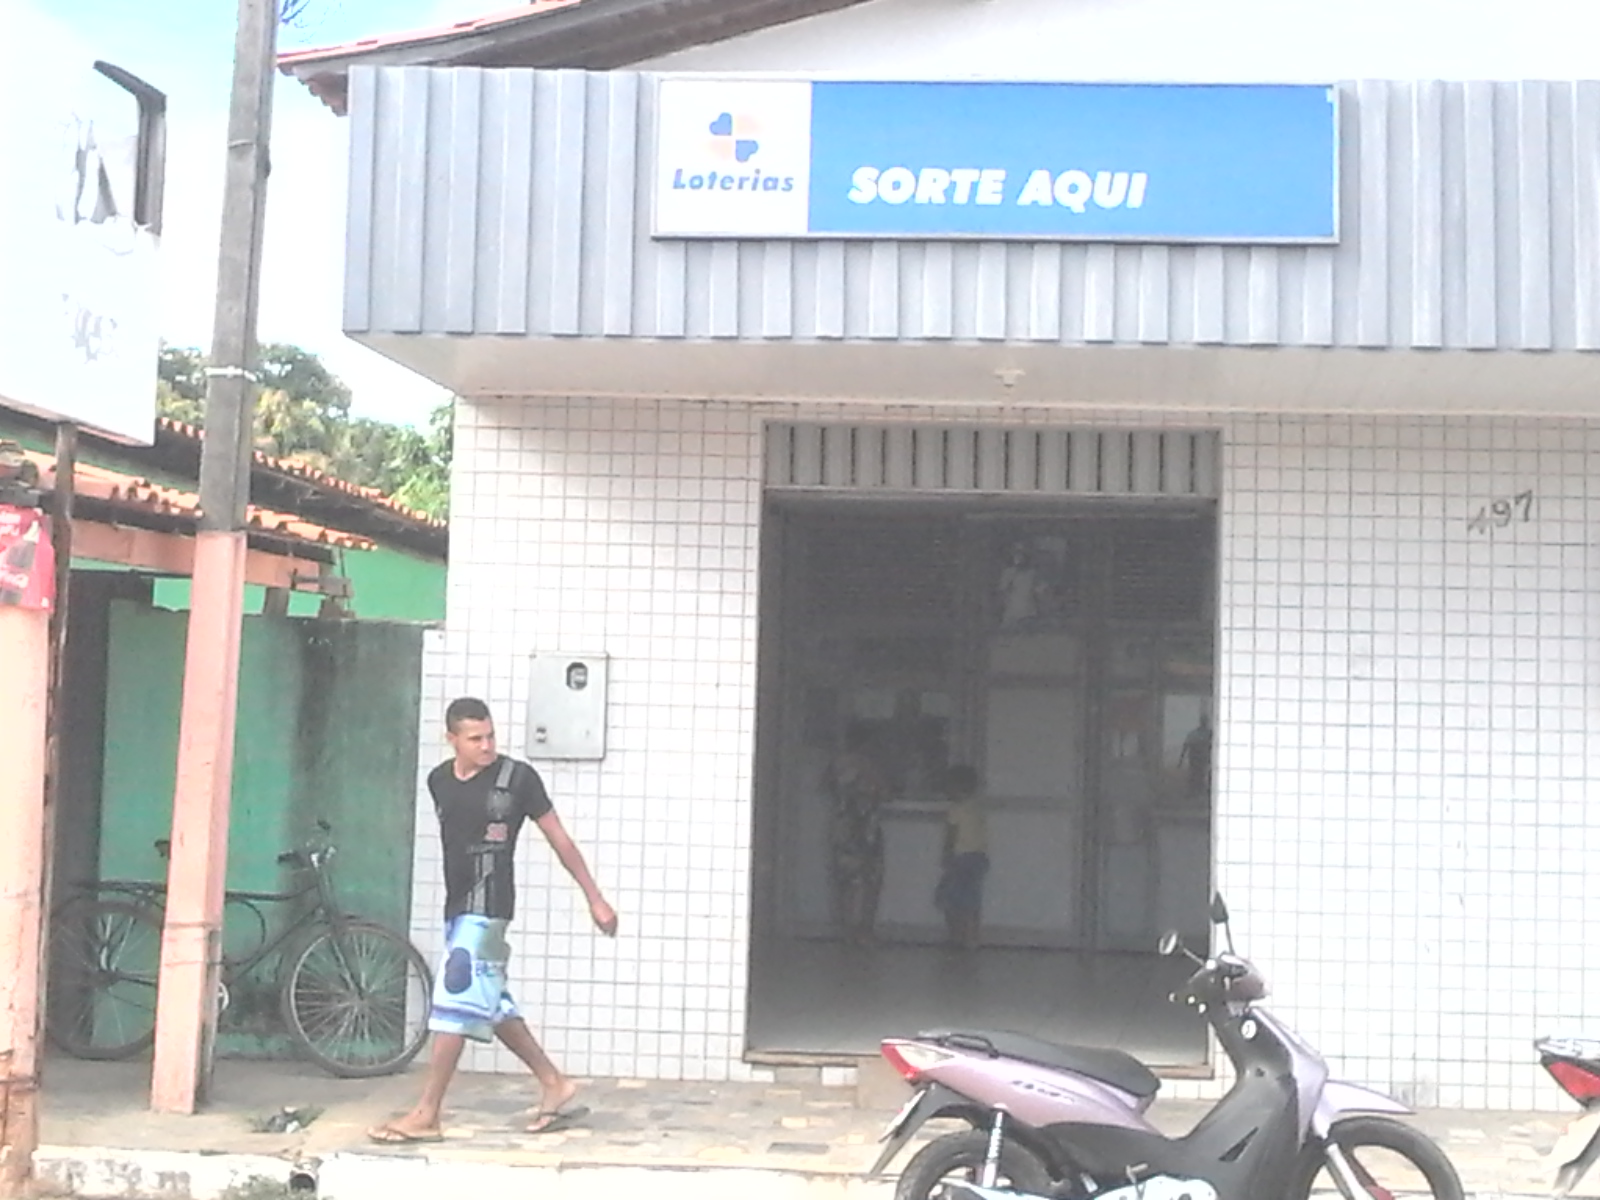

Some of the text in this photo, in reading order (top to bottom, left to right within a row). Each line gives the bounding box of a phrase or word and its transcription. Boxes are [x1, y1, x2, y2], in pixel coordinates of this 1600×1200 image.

[672, 170, 796, 193] Loterias
[849, 166, 1148, 214] SORTE AQUI
[1467, 490, 1533, 534] 497
